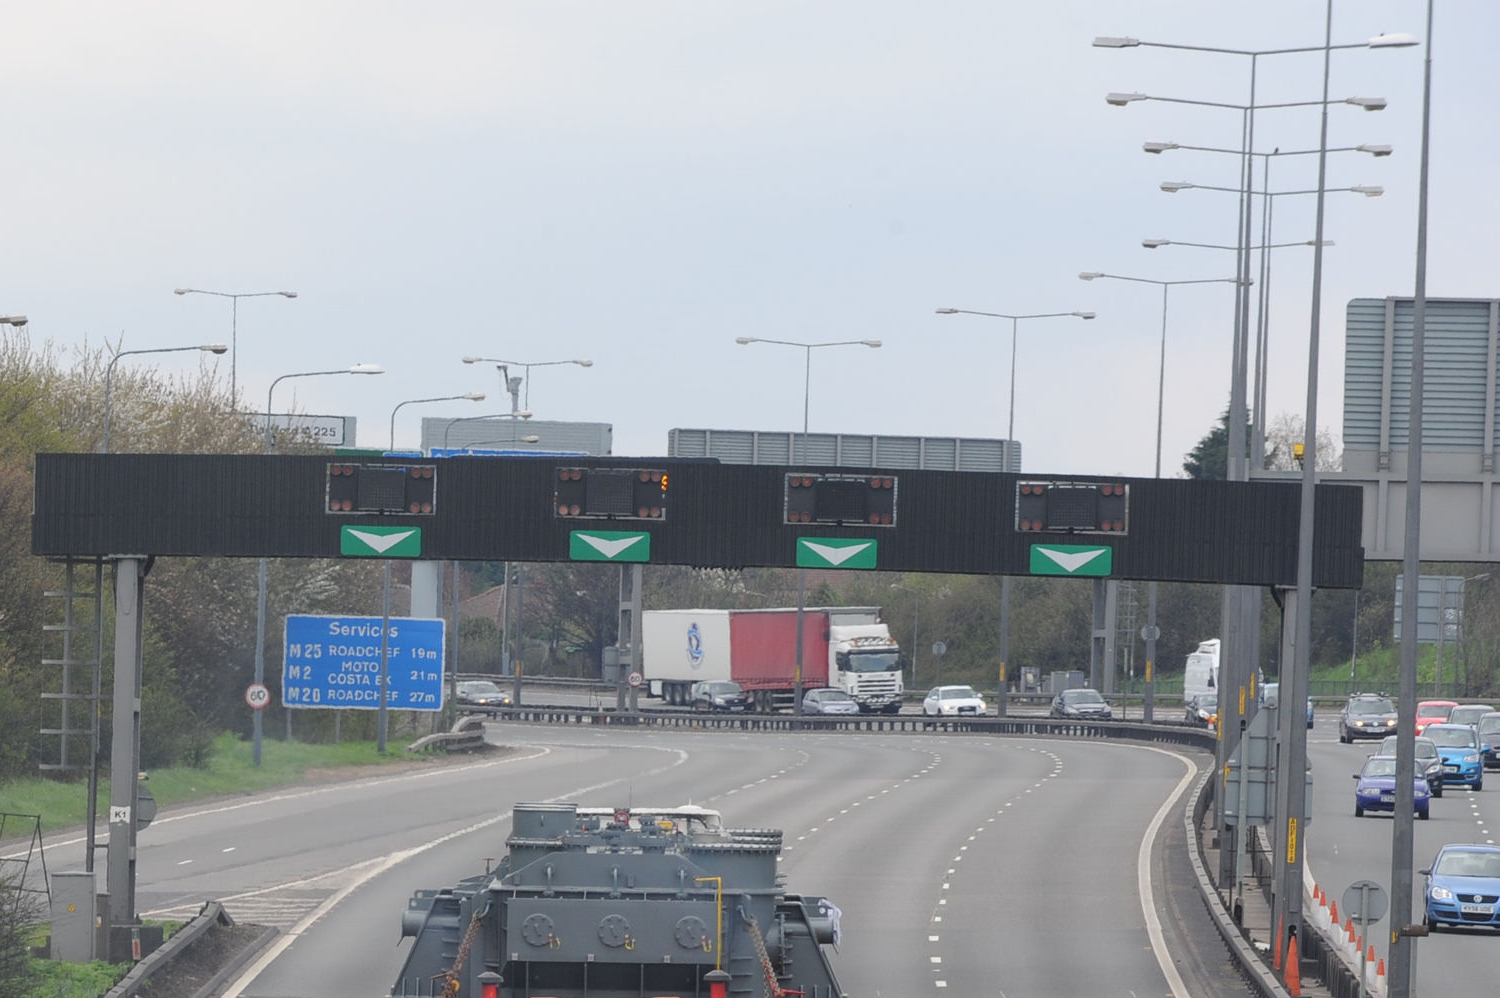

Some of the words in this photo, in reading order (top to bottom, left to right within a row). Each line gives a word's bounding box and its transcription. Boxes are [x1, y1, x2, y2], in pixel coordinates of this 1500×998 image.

[341, 661, 380, 673] MOTO
[327, 673, 371, 685] COSTA
[250, 690, 265, 701] 60
[114, 811, 127, 819] K1
